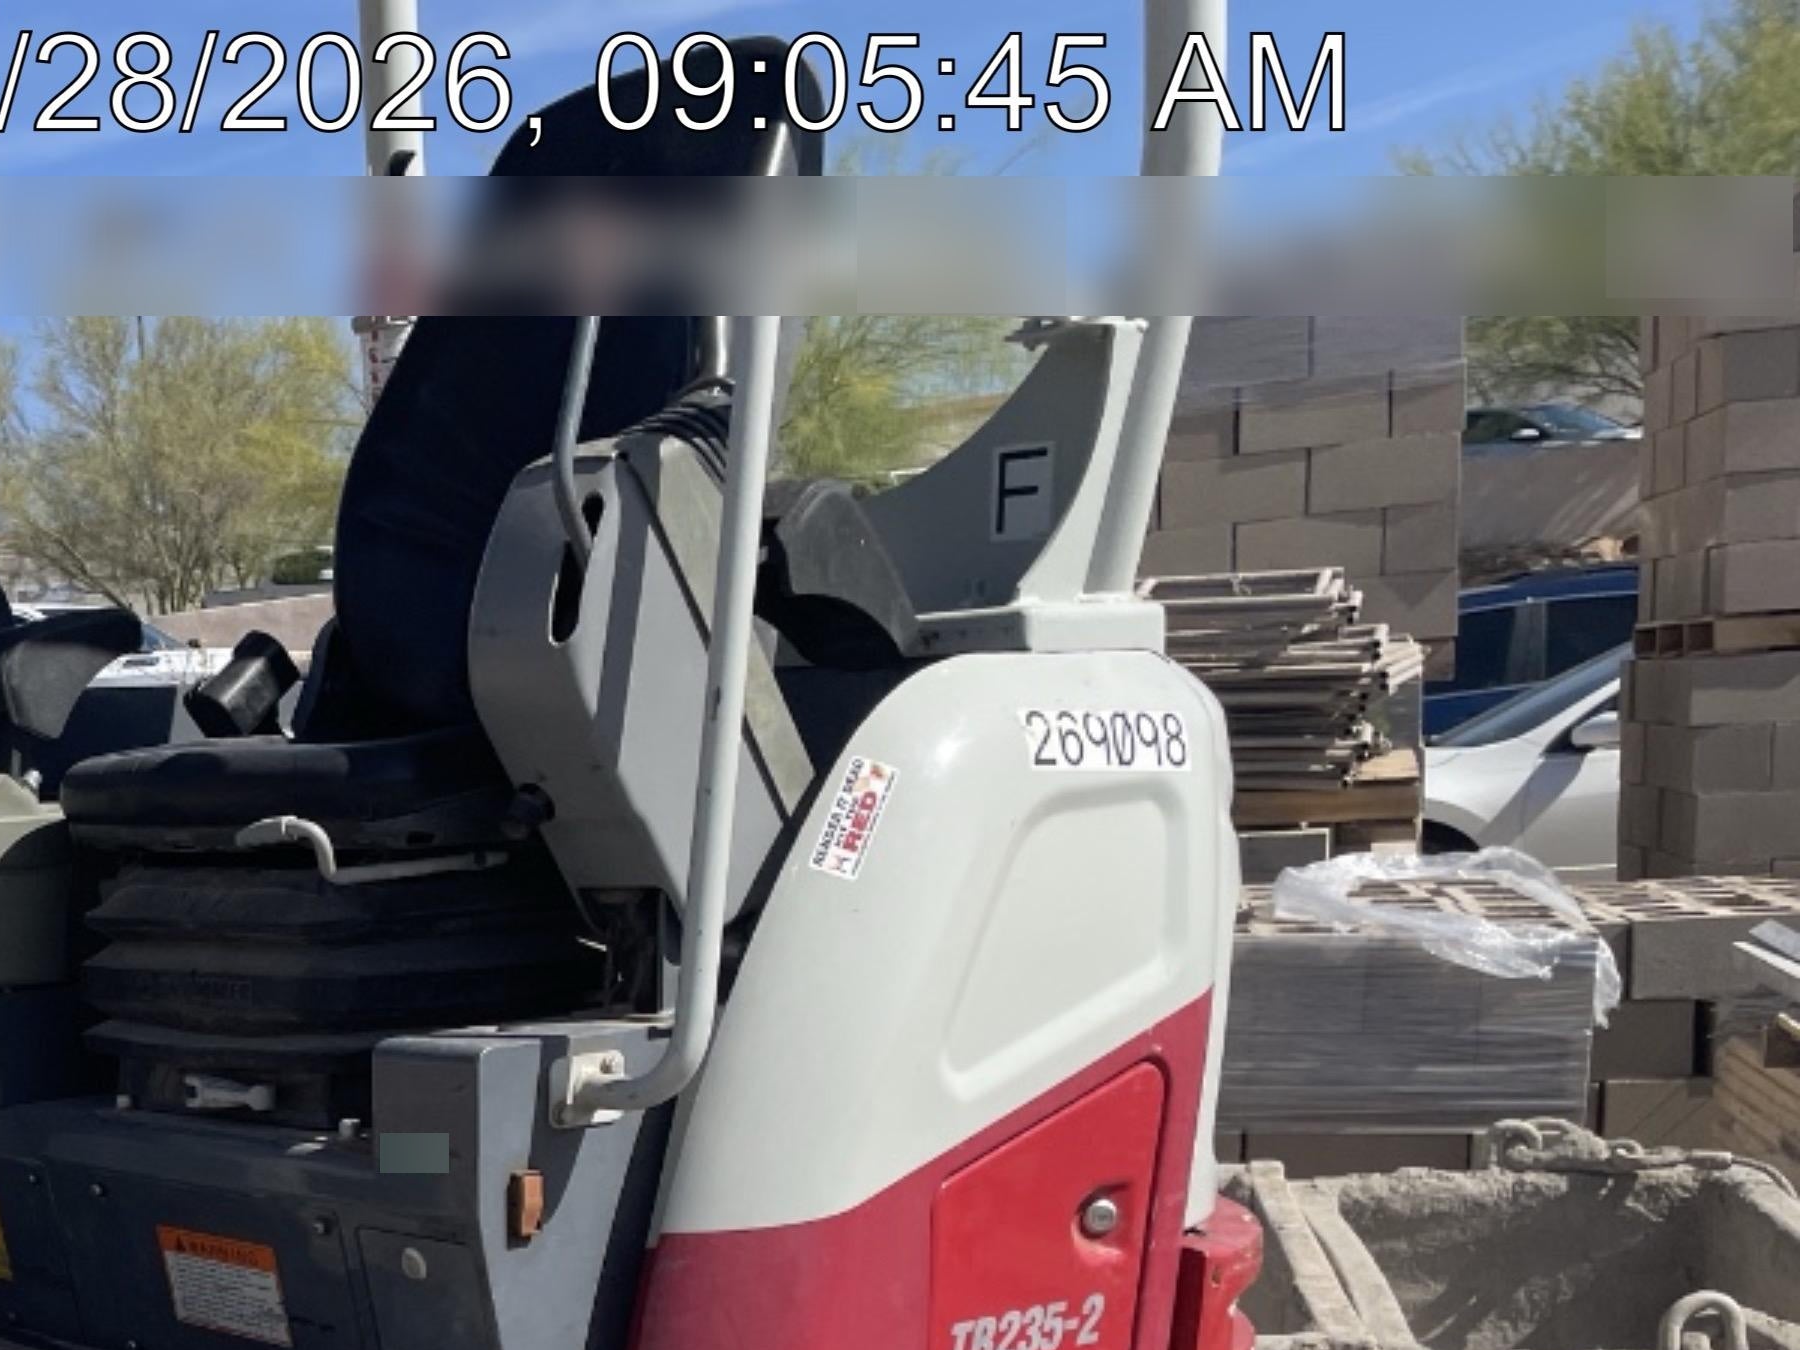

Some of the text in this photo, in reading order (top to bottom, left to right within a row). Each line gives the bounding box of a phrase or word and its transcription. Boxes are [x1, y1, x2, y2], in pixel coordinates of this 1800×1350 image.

[996, 447, 1048, 535] F
[1025, 710, 1186, 766] 269098
[842, 791, 877, 852] RED
